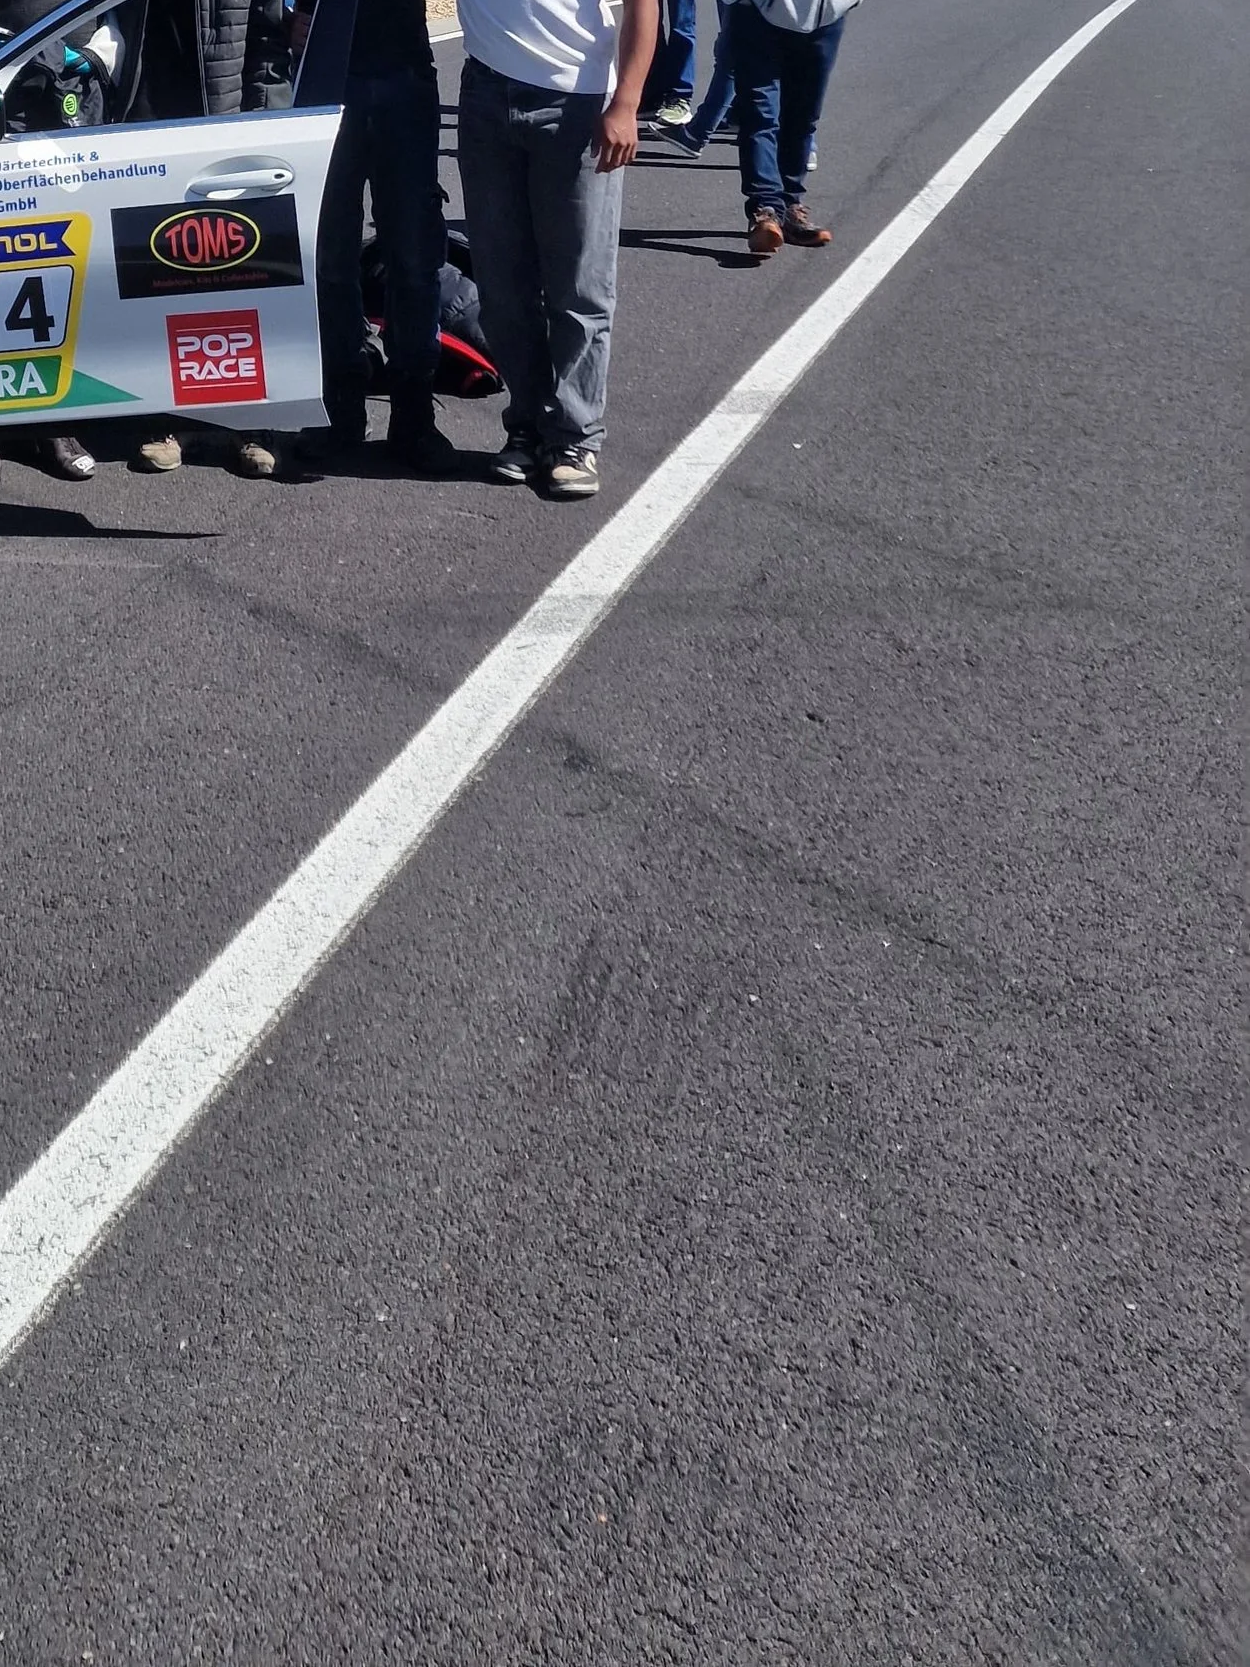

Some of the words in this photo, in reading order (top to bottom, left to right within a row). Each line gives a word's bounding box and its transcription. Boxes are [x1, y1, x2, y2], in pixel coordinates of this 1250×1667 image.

[89, 151, 100, 162] &
[165, 216, 246, 264] TOMS
[176, 332, 253, 360] POP
[179, 357, 257, 382] RACE
